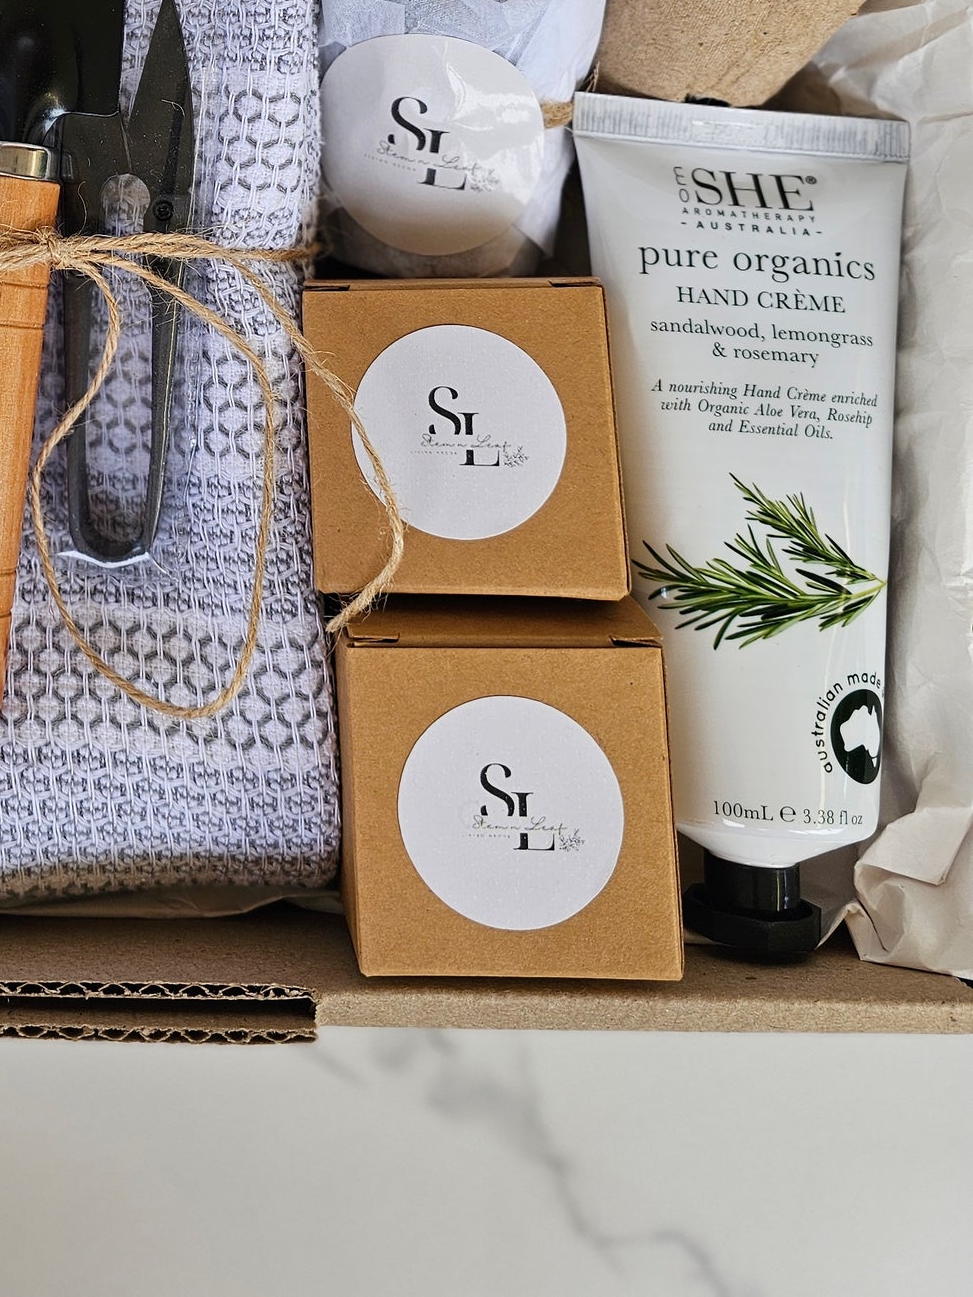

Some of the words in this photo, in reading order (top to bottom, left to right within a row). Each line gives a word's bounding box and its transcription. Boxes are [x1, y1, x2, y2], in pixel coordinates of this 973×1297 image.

[682, 207, 815, 223] AROMATHERAPY
[638, 245, 719, 275] pure
[733, 252, 876, 283] organics
[676, 285, 749, 307] HAND
[757, 289, 846, 314] CRÈME
[650, 318, 766, 342] sandalwood,
[771, 324, 874, 349] lemongrass
[712, 342, 728, 358] &
[733, 347, 820, 368] rosemary
[651, 379, 664, 392] A
[669, 381, 738, 400] nourishing
[743, 384, 782, 399] Hand
[786, 387, 827, 403] Crème
[831, 391, 878, 407] enriched
[661, 398, 692, 412] with
[697, 400, 749, 417] Organic
[754, 403, 784, 418] Aloe
[790, 405, 820, 422] Vera,
[827, 408, 873, 428] Rosehip
[708, 419, 733, 433] and
[739, 420, 799, 437] Essential
[804, 424, 834, 440] Oils.
[811, 682, 843, 773] australian
[847, 671, 882, 690] made
[713, 800, 774, 822] 100mL
[803, 809, 835, 825] 3.38
[839, 810, 849, 825] fl
[851, 814, 863, 825] oz
